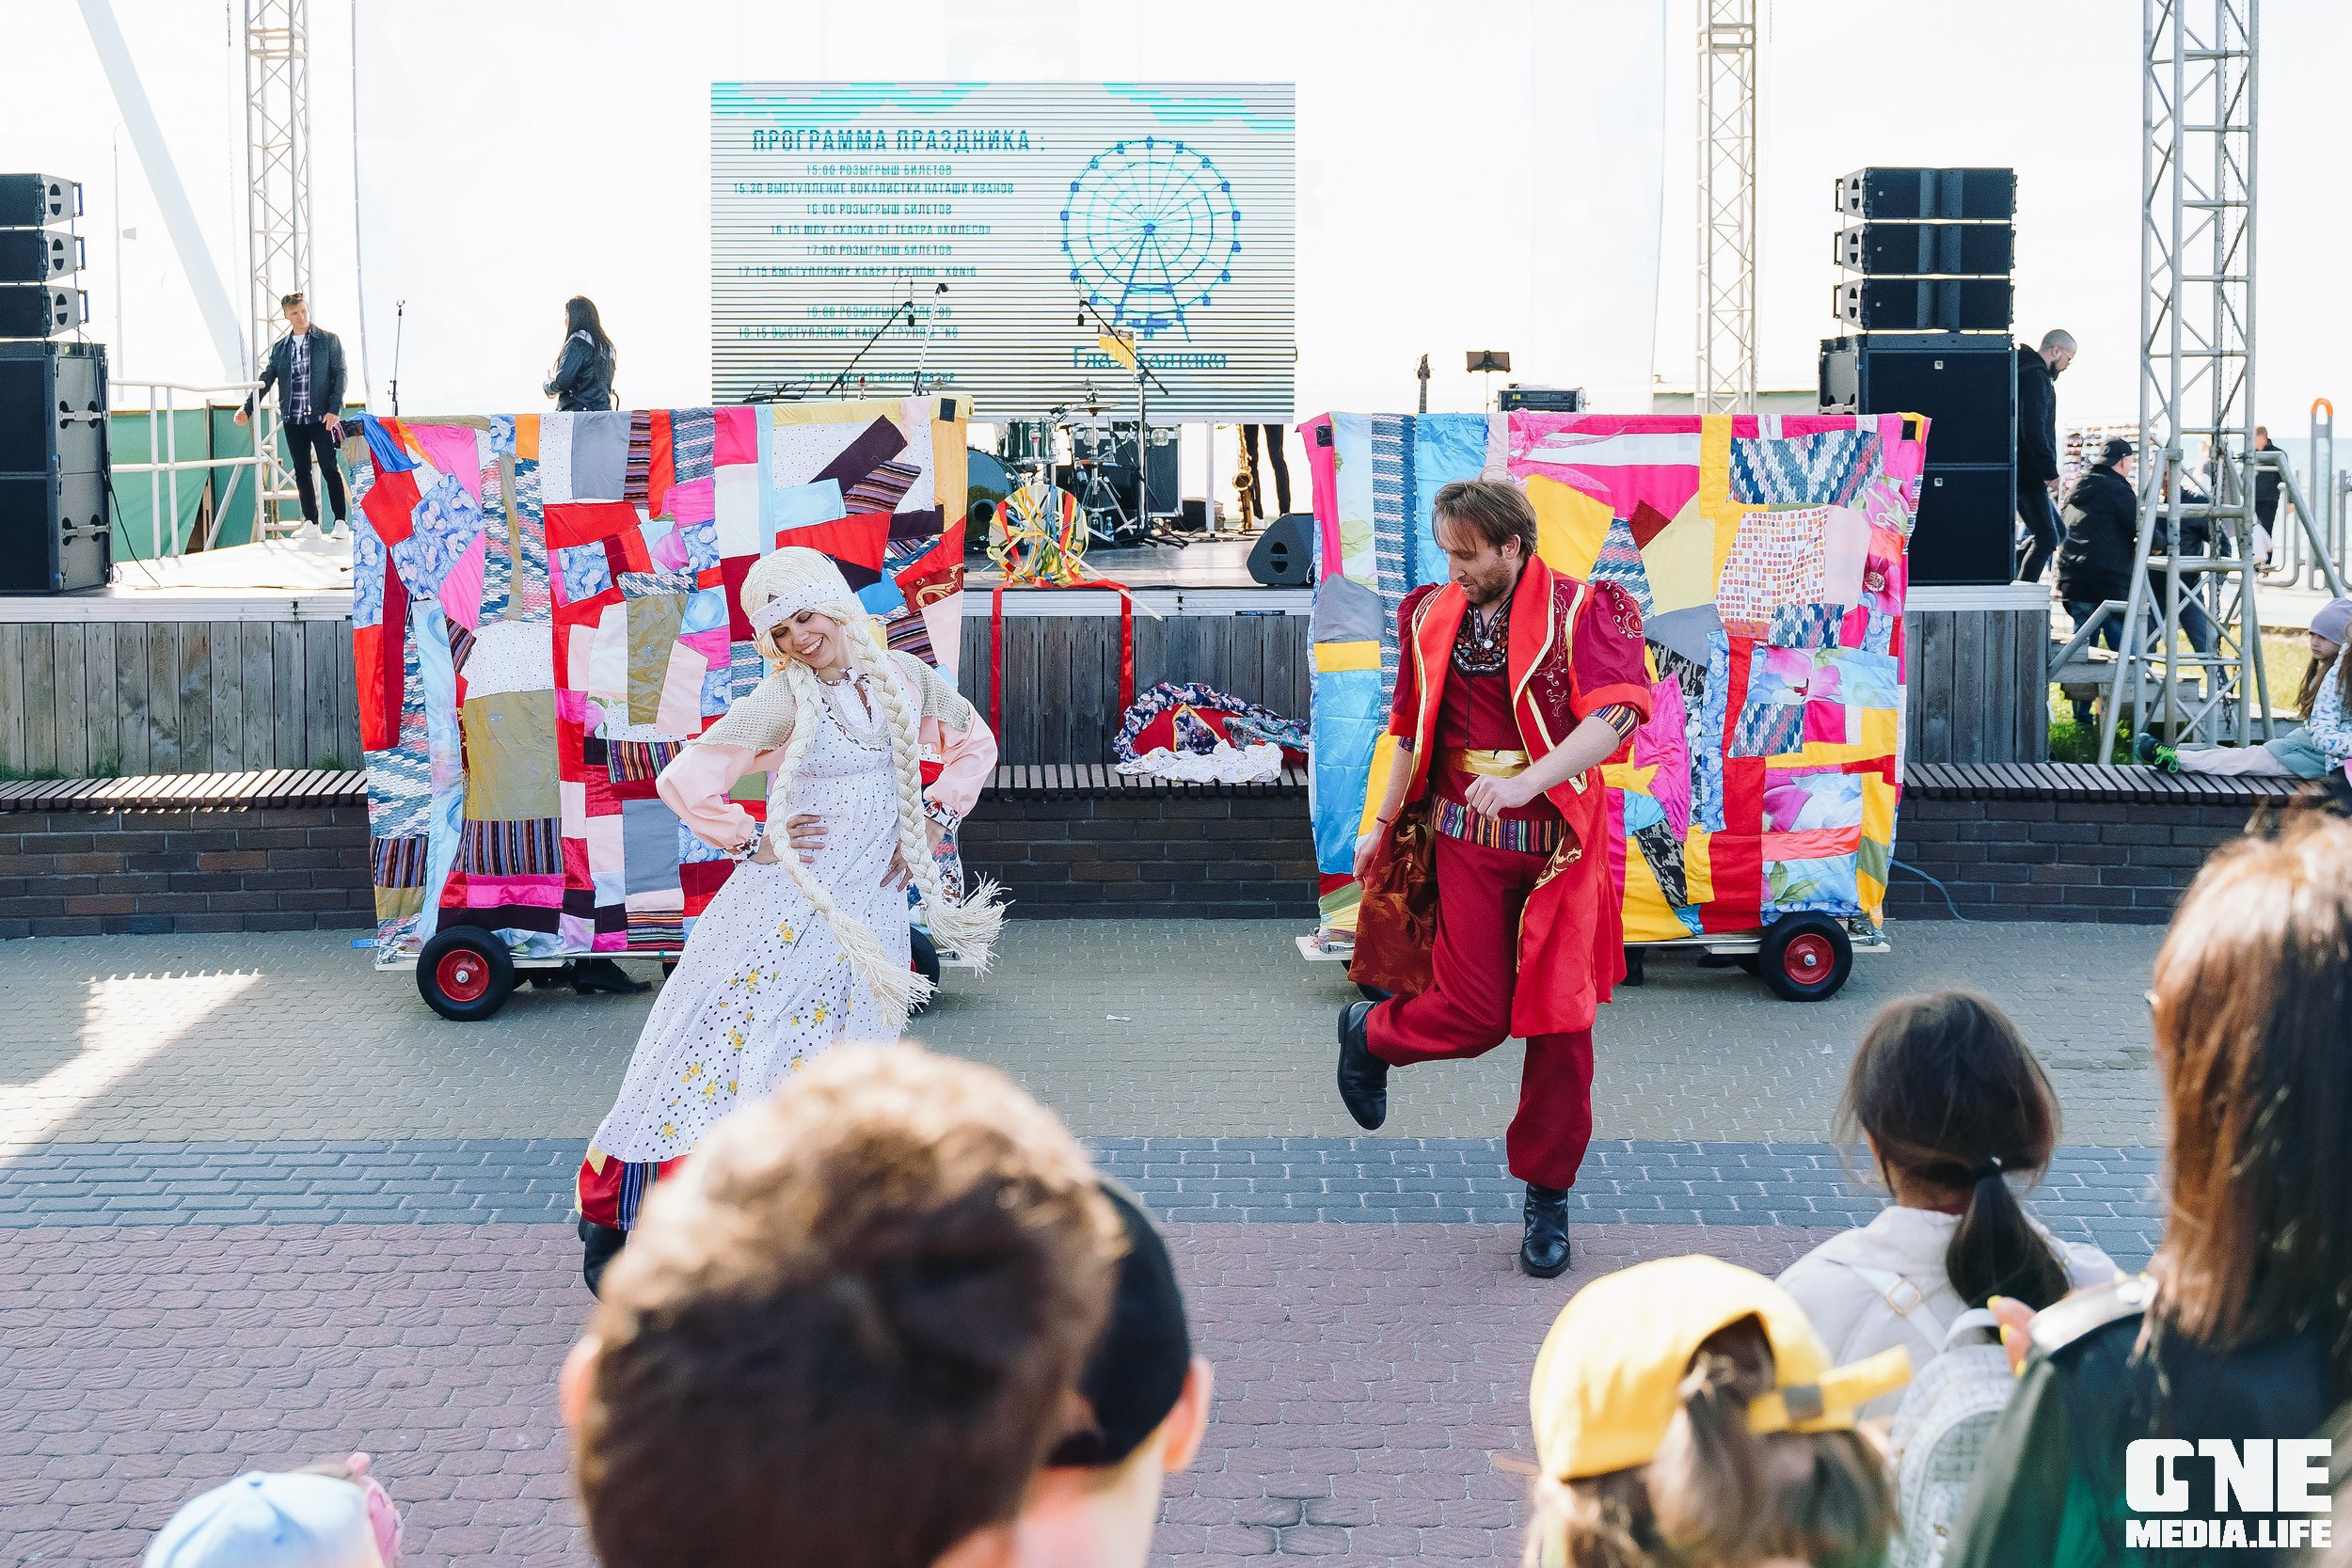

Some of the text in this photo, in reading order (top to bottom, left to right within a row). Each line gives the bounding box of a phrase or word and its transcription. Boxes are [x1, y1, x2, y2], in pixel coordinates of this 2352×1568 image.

[753, 129, 888, 151] ПРОГРАММА
[896, 129, 1030, 153] ПРАЗДНИКА
[807, 165, 952, 176] 15:00 РОЗЫГРЫШ БИЛЕТОВ
[768, 182, 846, 194] ВЫСТУПЛЕНИЕ
[850, 182, 921, 194] ВОКАЛИСТКИ
[925, 182, 968, 194] НАТАШИ
[840, 203, 900, 214] РОЗЫГРЫШ
[903, 203, 952, 214] БИЛЕТОВ
[804, 225, 873, 235] ШОУ-СКАЗКА
[896, 225, 932, 235] ТЕАТРА
[840, 245, 900, 256] РОЗЫГРЫШ
[903, 245, 952, 256] БИЛЕТОВ
[772, 265, 850, 277] ВЫСТУПЛЕНИЕ
[855, 265, 888, 277] КАВЕР
[893, 265, 936, 277] ГРУППЫ
